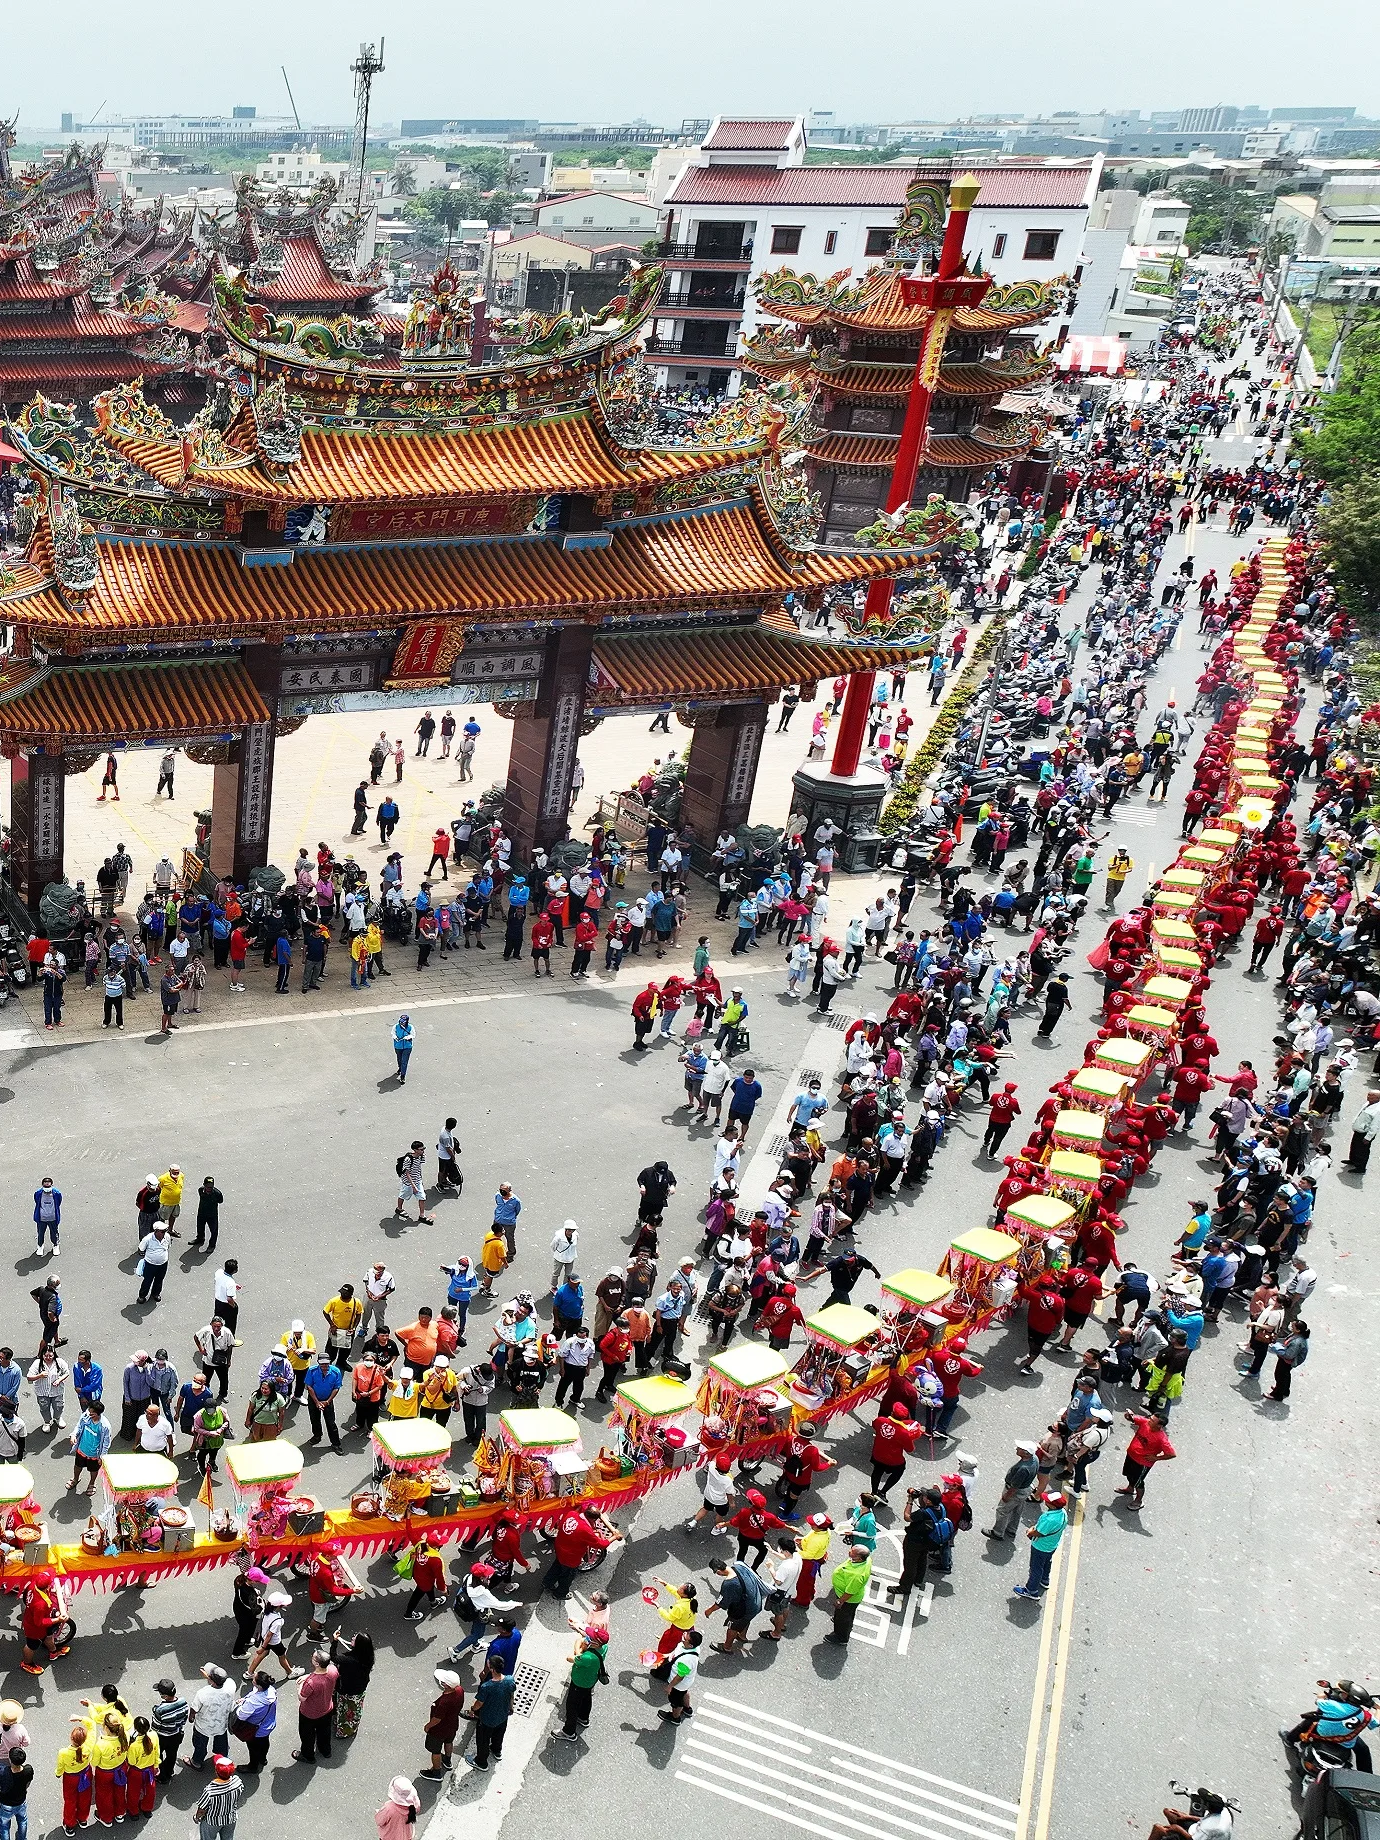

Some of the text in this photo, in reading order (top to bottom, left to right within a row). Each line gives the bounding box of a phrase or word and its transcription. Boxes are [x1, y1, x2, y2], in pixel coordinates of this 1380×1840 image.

[366, 508, 491, 531] 鹿耳門天后宮
[412, 628, 436, 671] 鹿耳門
[286, 667, 363, 687] 國泰民安
[460, 657, 537, 677] 風調雨順
